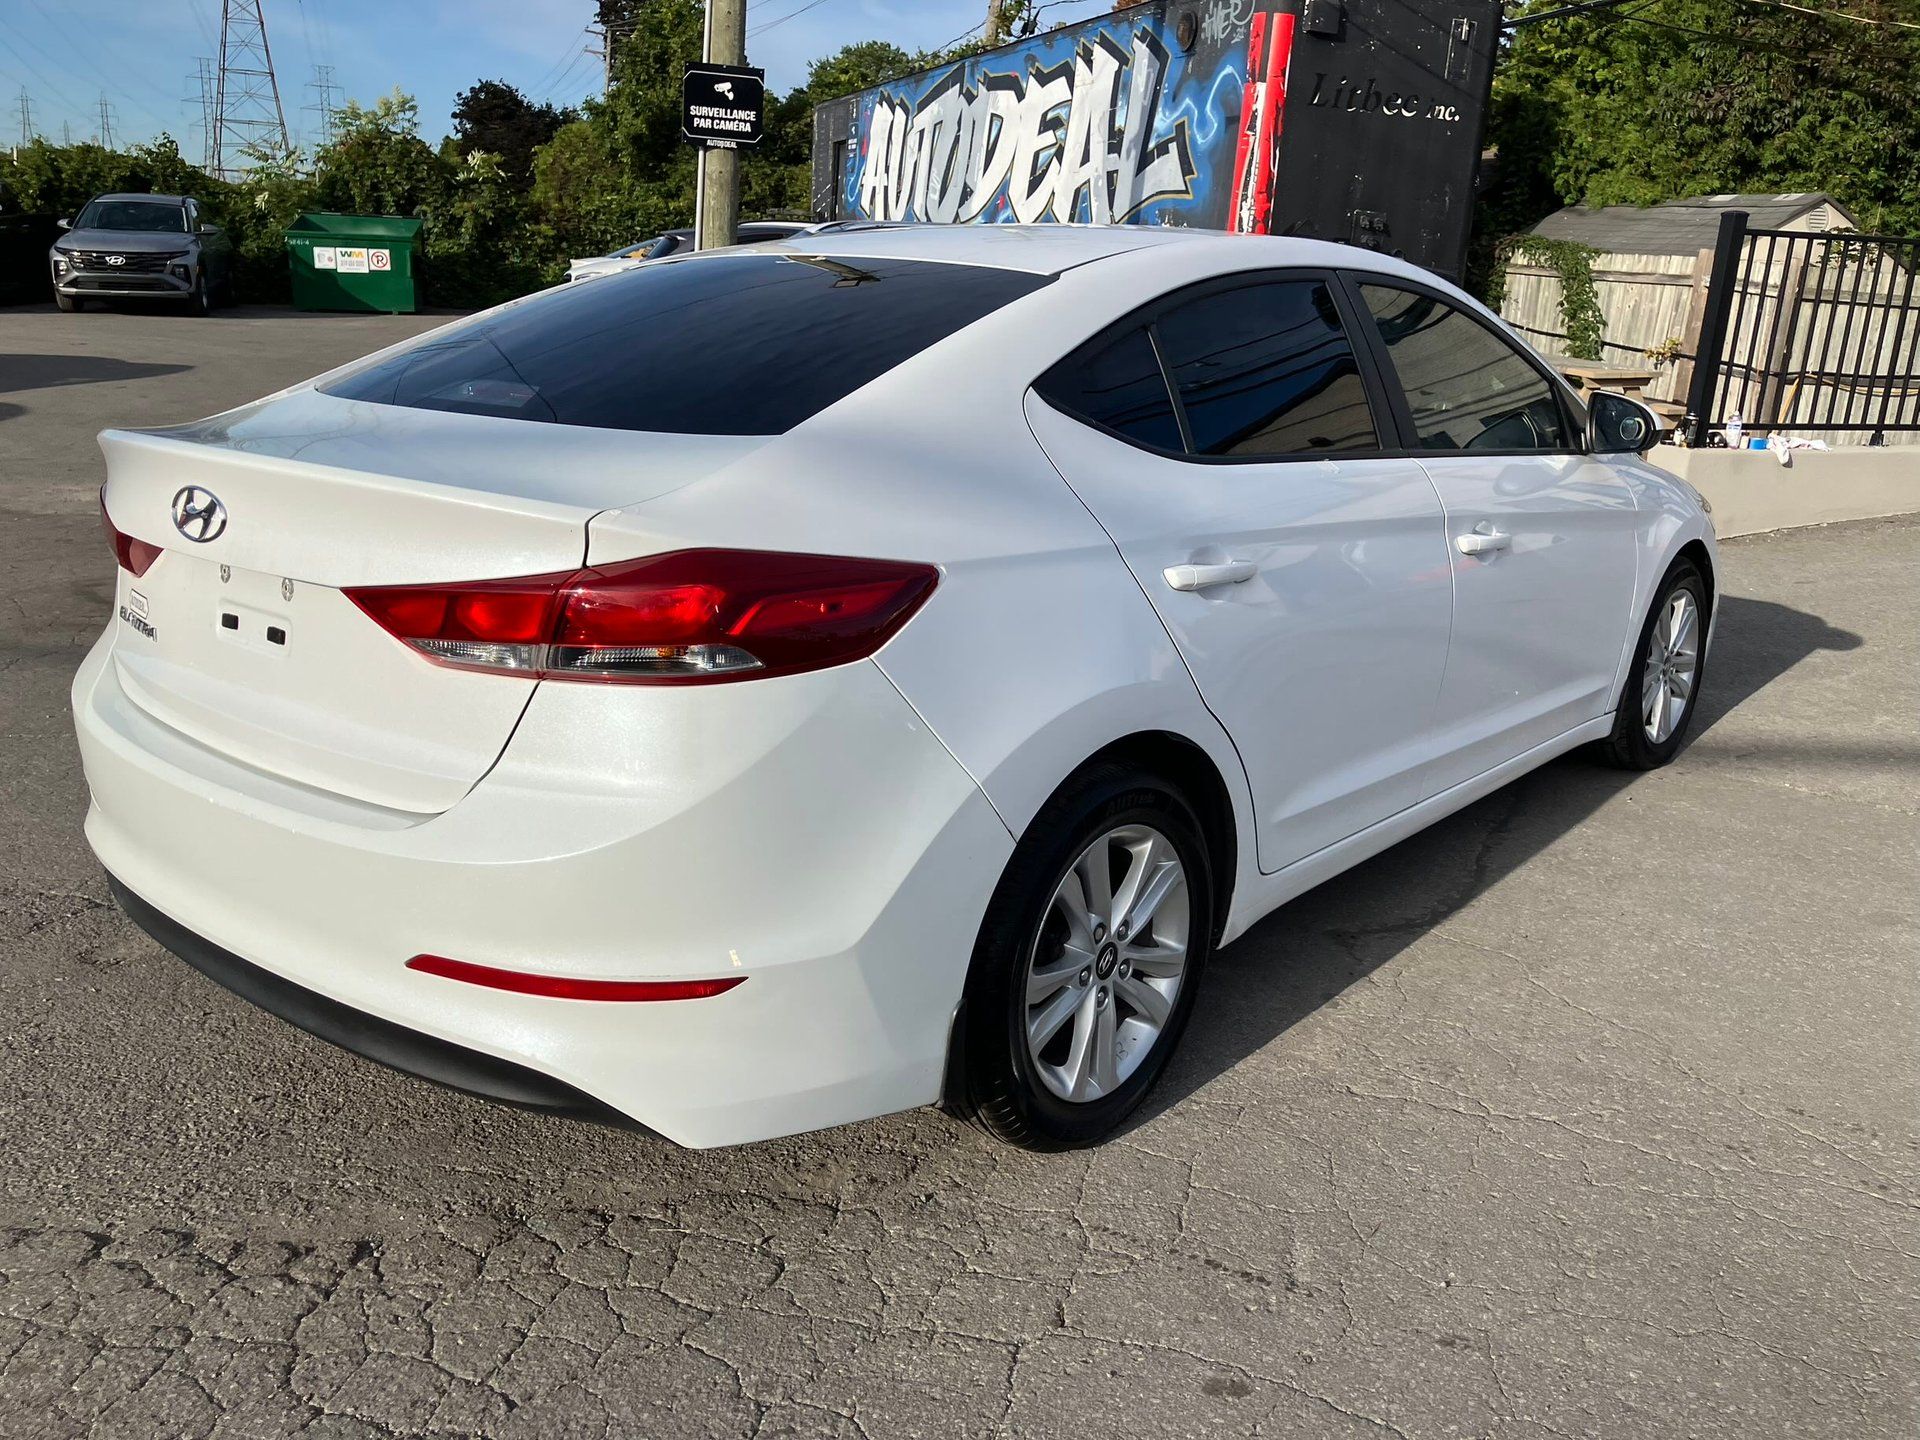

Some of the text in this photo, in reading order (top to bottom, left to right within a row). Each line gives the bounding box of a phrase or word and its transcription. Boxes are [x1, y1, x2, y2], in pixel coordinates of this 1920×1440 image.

[689, 105, 756, 121] SURVEILLANCE
[693, 118, 752, 133] PAR CAMÉRA
[859, 28, 1196, 223] AUTODEAL
[340, 250, 363, 258] WM
